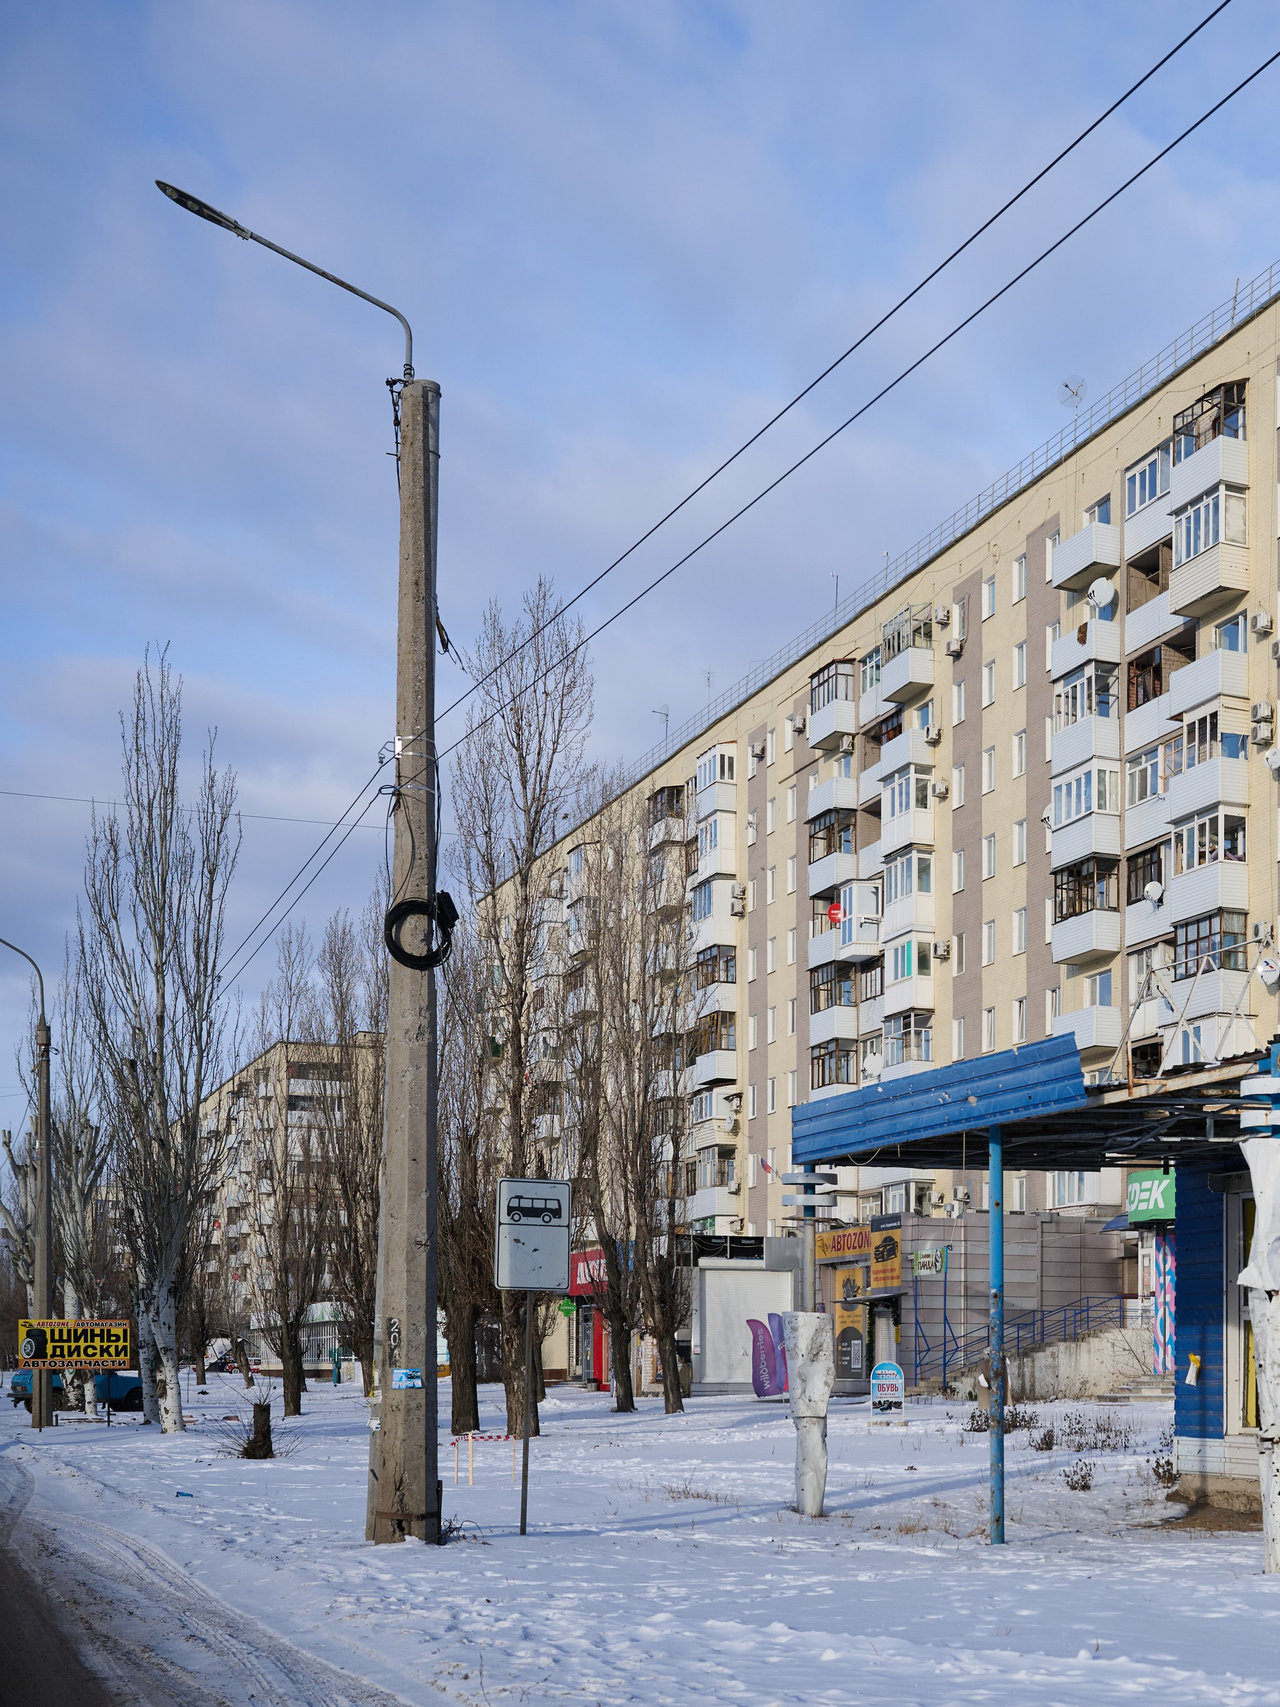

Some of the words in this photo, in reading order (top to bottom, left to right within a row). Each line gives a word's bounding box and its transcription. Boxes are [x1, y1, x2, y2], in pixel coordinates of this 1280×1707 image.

[831, 1230, 872, 1253] АВТОZON
[50, 1328, 128, 1343] ШИНЫ
[49, 1344, 128, 1359] ДИСКИ
[757, 1328, 771, 1390] wildberries
[22, 1360, 126, 1368] АВТОЗАПЧАСТИ
[877, 1383, 899, 1392] ОБУВЬ
